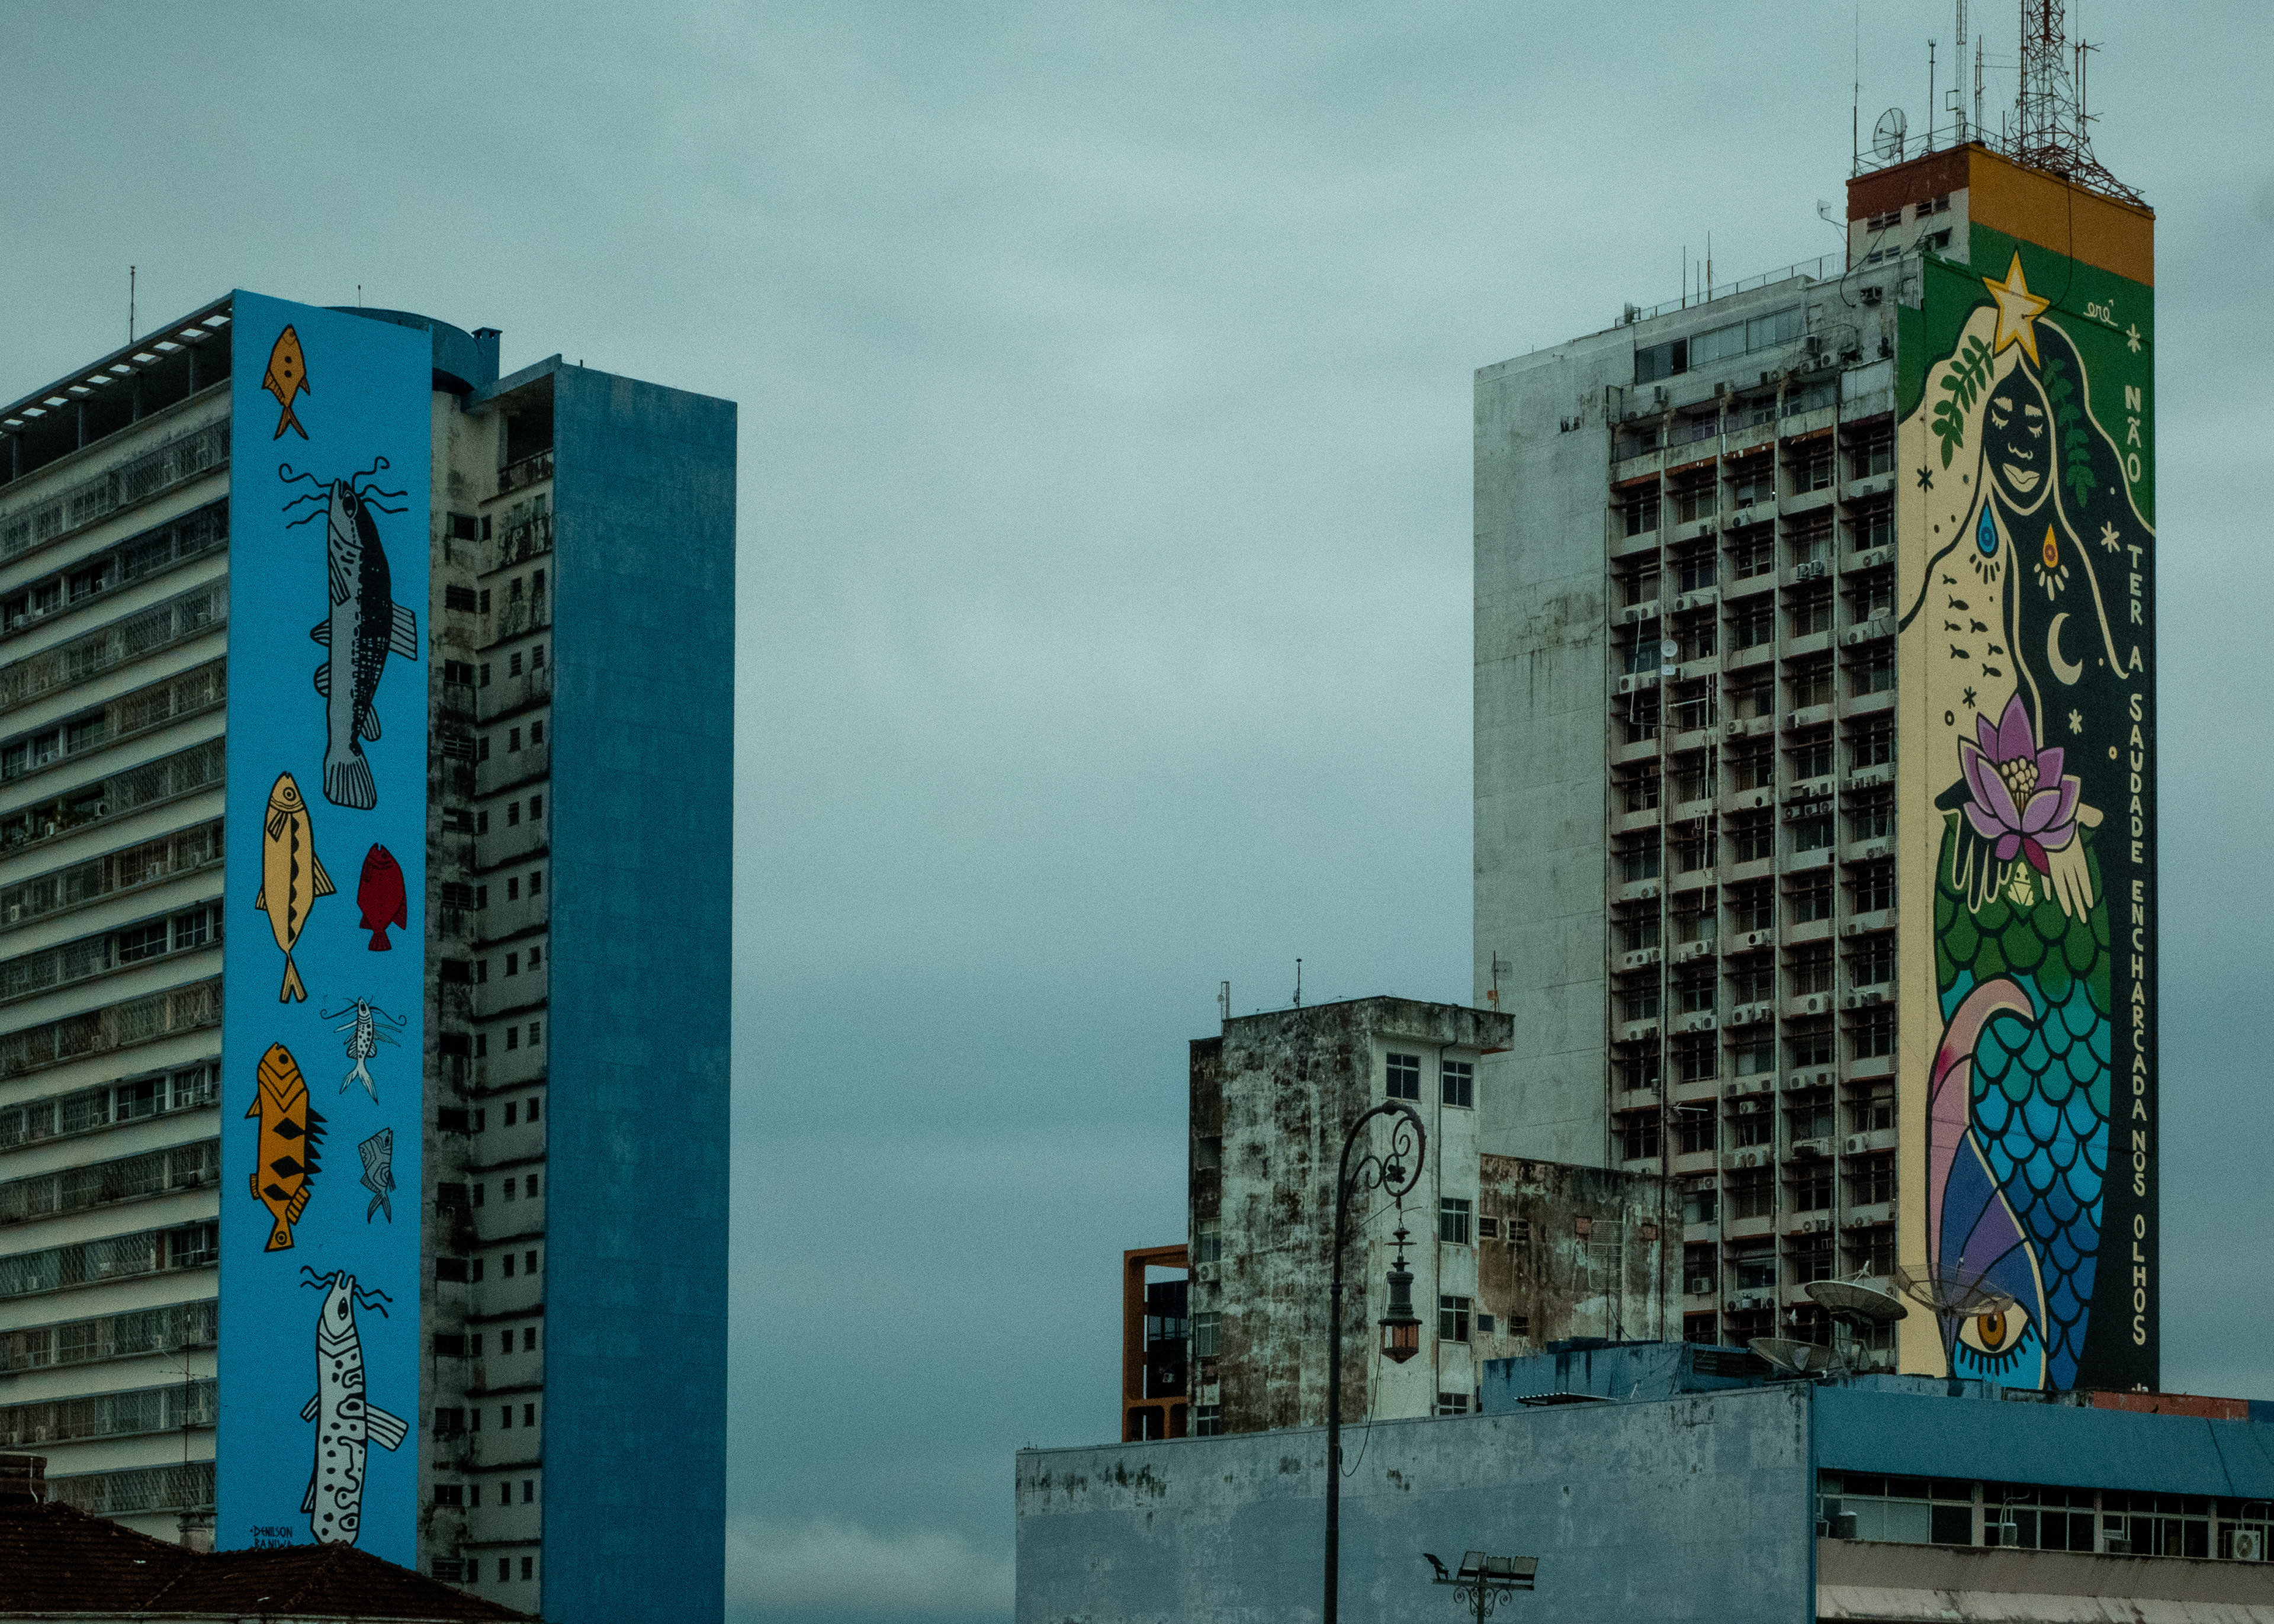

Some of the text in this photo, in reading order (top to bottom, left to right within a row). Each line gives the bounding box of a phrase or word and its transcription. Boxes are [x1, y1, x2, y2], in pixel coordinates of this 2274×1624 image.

[2125, 385, 2147, 1346] NÃO TER A SAUDADE ENCHARCADA NOS OLHOS
[253, 1525, 293, 1538] DENILSON
